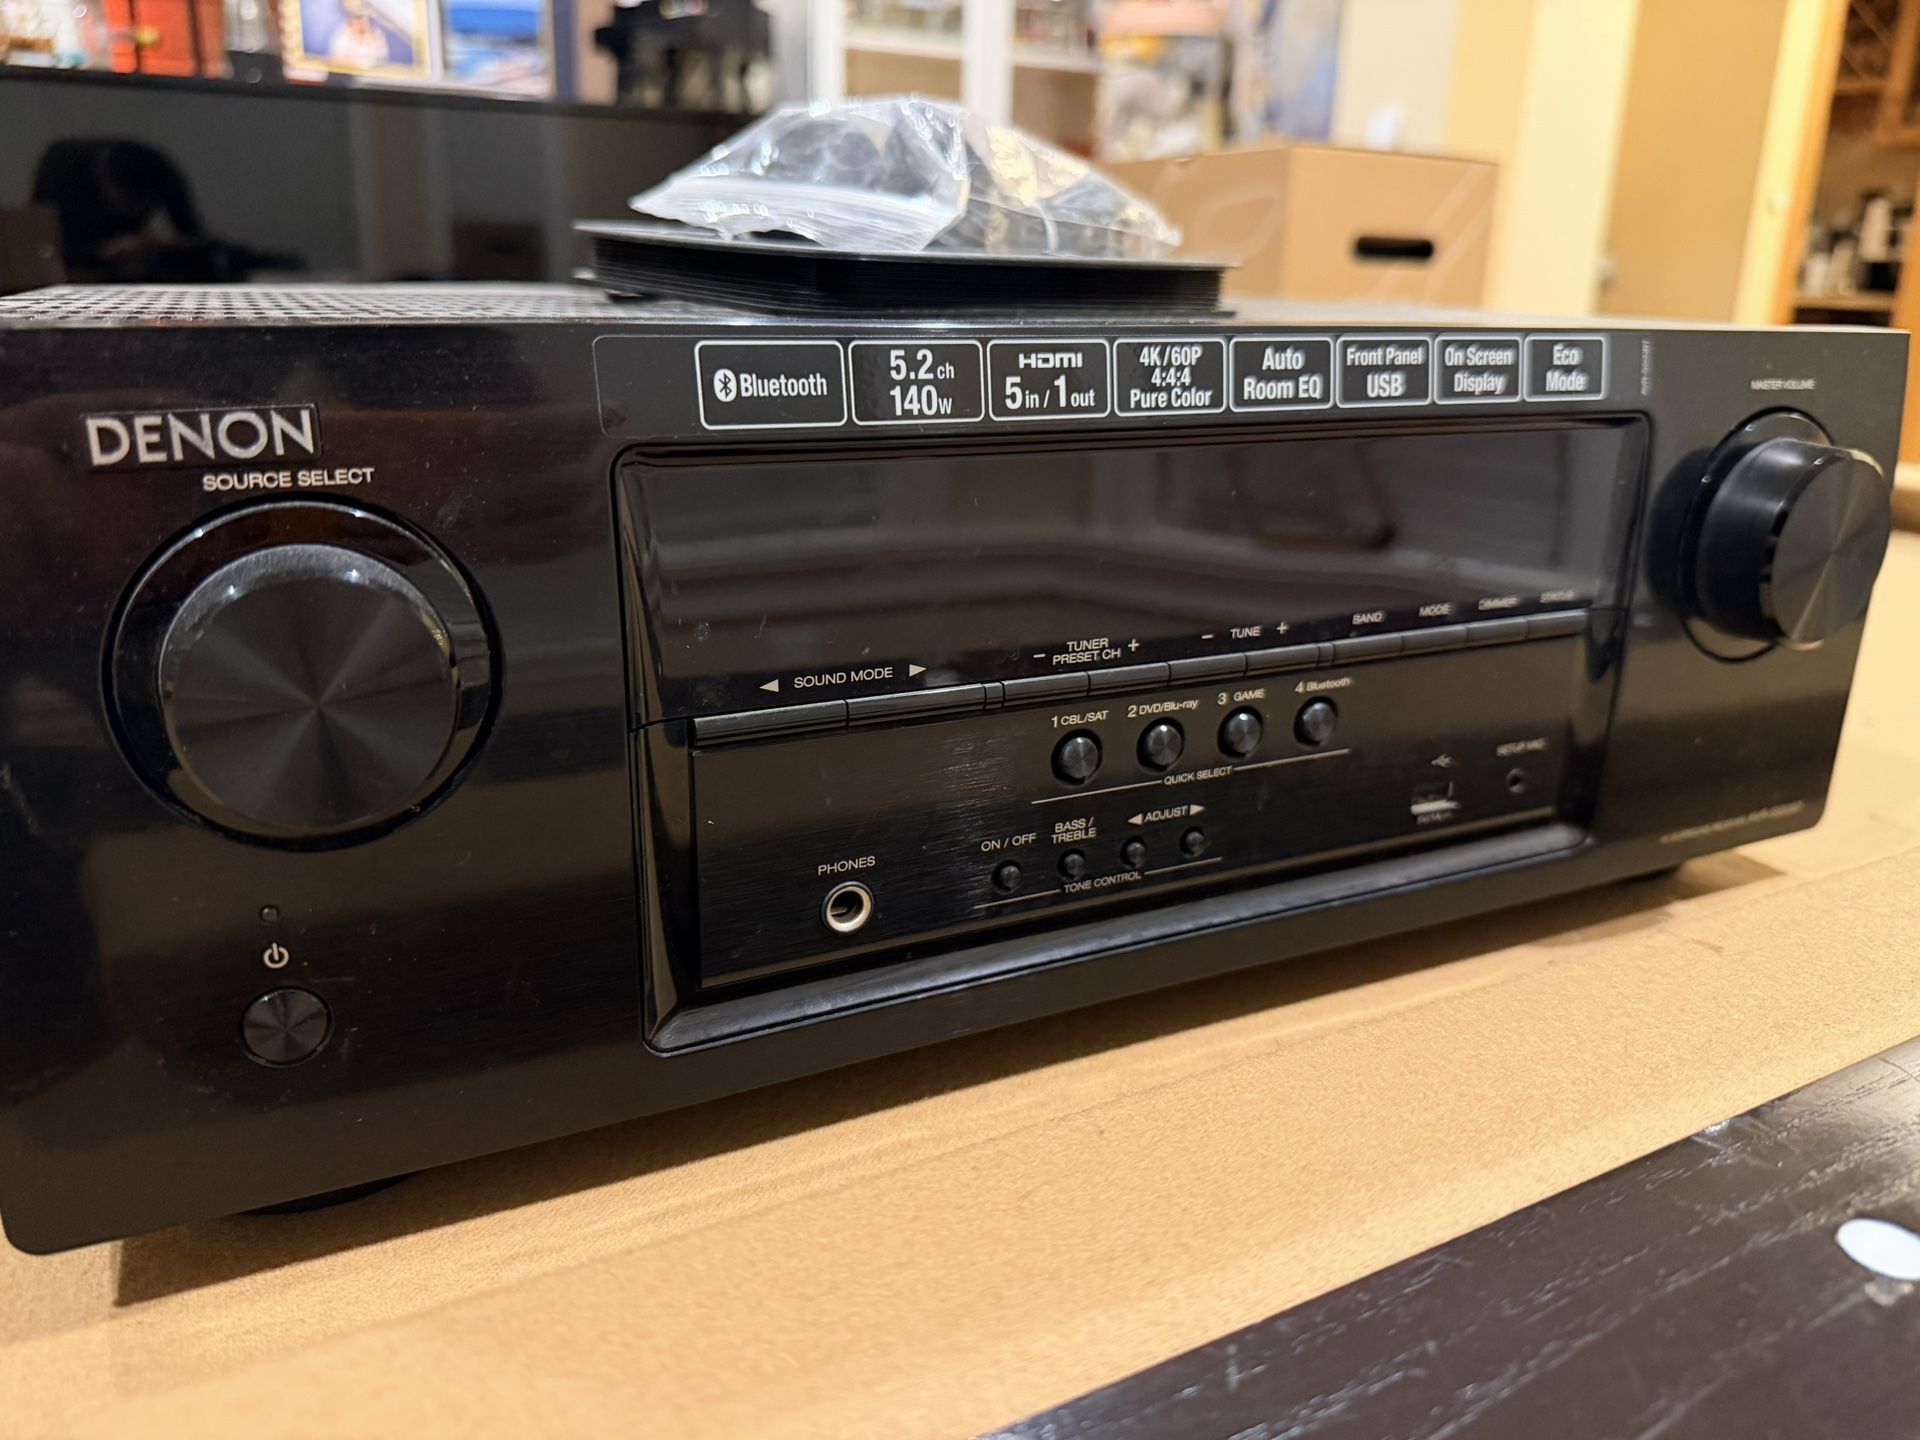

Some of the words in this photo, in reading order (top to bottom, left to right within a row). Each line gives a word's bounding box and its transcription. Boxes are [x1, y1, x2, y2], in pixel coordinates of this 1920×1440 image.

[1018, 352, 1083, 369] HDMI
[1139, 345, 1203, 367] 4K/60P
[1261, 346, 1305, 371] Auto
[1346, 345, 1383, 366] Front
[1385, 344, 1425, 365] Panel
[1444, 345, 1464, 366] On
[1466, 344, 1515, 365] Screen
[1552, 344, 1582, 365] Eco
[739, 371, 828, 398] Bluetooth
[1150, 366, 1192, 387] 4:4:4
[1366, 373, 1404, 398] USB
[1454, 371, 1506, 395] Display
[1545, 370, 1588, 392] Mode
[1130, 388, 1168, 409] Pure
[1170, 386, 1213, 407] Color
[1243, 377, 1295, 400] Room
[1298, 375, 1323, 399] EQ
[86, 409, 314, 466] DENON
[203, 471, 293, 492] SOURCE
[298, 467, 375, 488] SELECT
[1352, 612, 1386, 625] BAND
[1419, 602, 1452, 617] MODE
[1230, 626, 1261, 639] TUNE
[1066, 637, 1109, 652] TUNER
[1052, 650, 1100, 666] PRESET
[1102, 647, 1122, 660] CH
[793, 673, 847, 690] SOUND
[850, 666, 893, 684] MODE
[1294, 680, 1304, 693] 4
[1306, 677, 1351, 692] Bluetooth
[1217, 692, 1227, 705] 3
[1233, 688, 1266, 702] GAME
[1051, 715, 1058, 728] 1
[1060, 710, 1109, 726] CBL/SAT
[1127, 705, 1138, 719] 2
[1138, 698, 1199, 716] DVD/Blu-ray
[1164, 771, 1195, 786] QUICK
[1196, 765, 1233, 781] SELECT
[1144, 805, 1188, 824] ADJUST
[981, 839, 1001, 852] ON
[1012, 832, 1037, 846] OFF
[1051, 827, 1097, 844] TREBLE
[817, 855, 877, 876] PHONES
[1064, 882, 1092, 893] TONE
[1093, 871, 1142, 889] CONTROL
